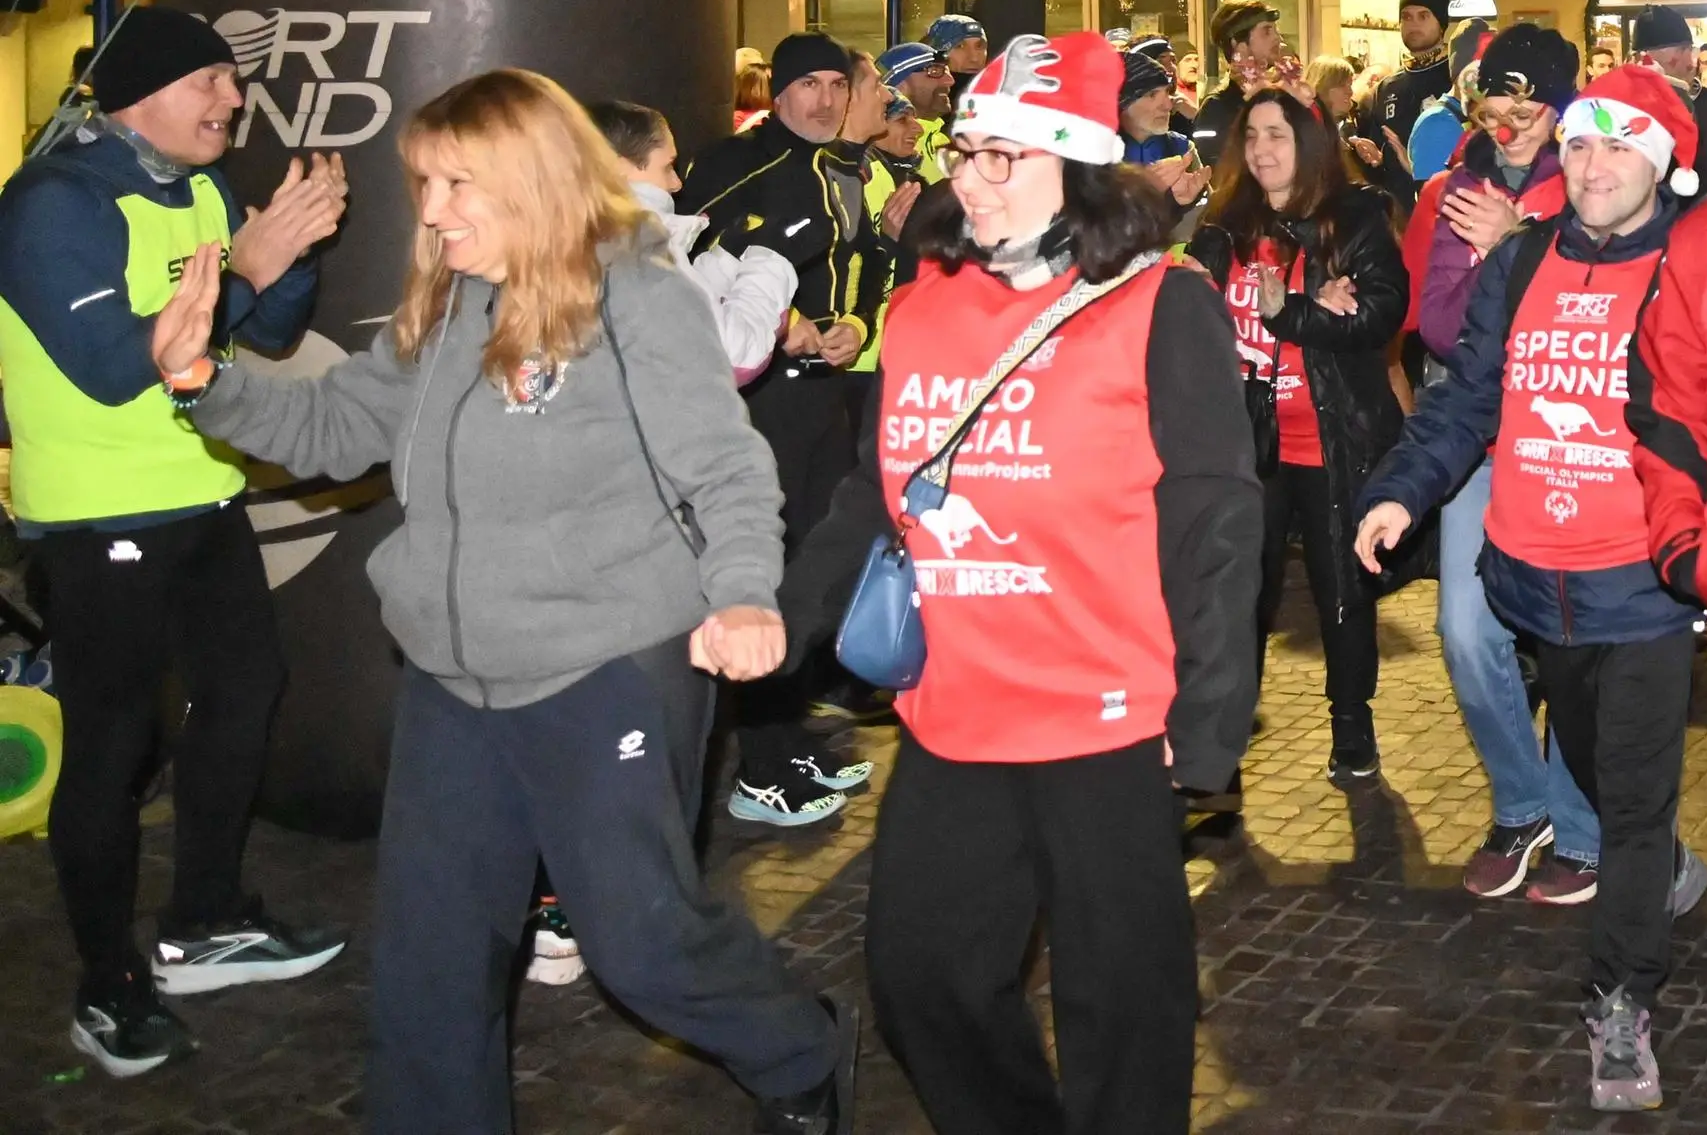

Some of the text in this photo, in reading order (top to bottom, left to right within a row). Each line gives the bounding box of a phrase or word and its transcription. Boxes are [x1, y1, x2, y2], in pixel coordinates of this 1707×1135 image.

[188, 8, 432, 79] ORT
[1514, 330, 1632, 362] SPECIA
[896, 373, 1036, 413] AMO
[1508, 362, 1630, 399] RUNNE
